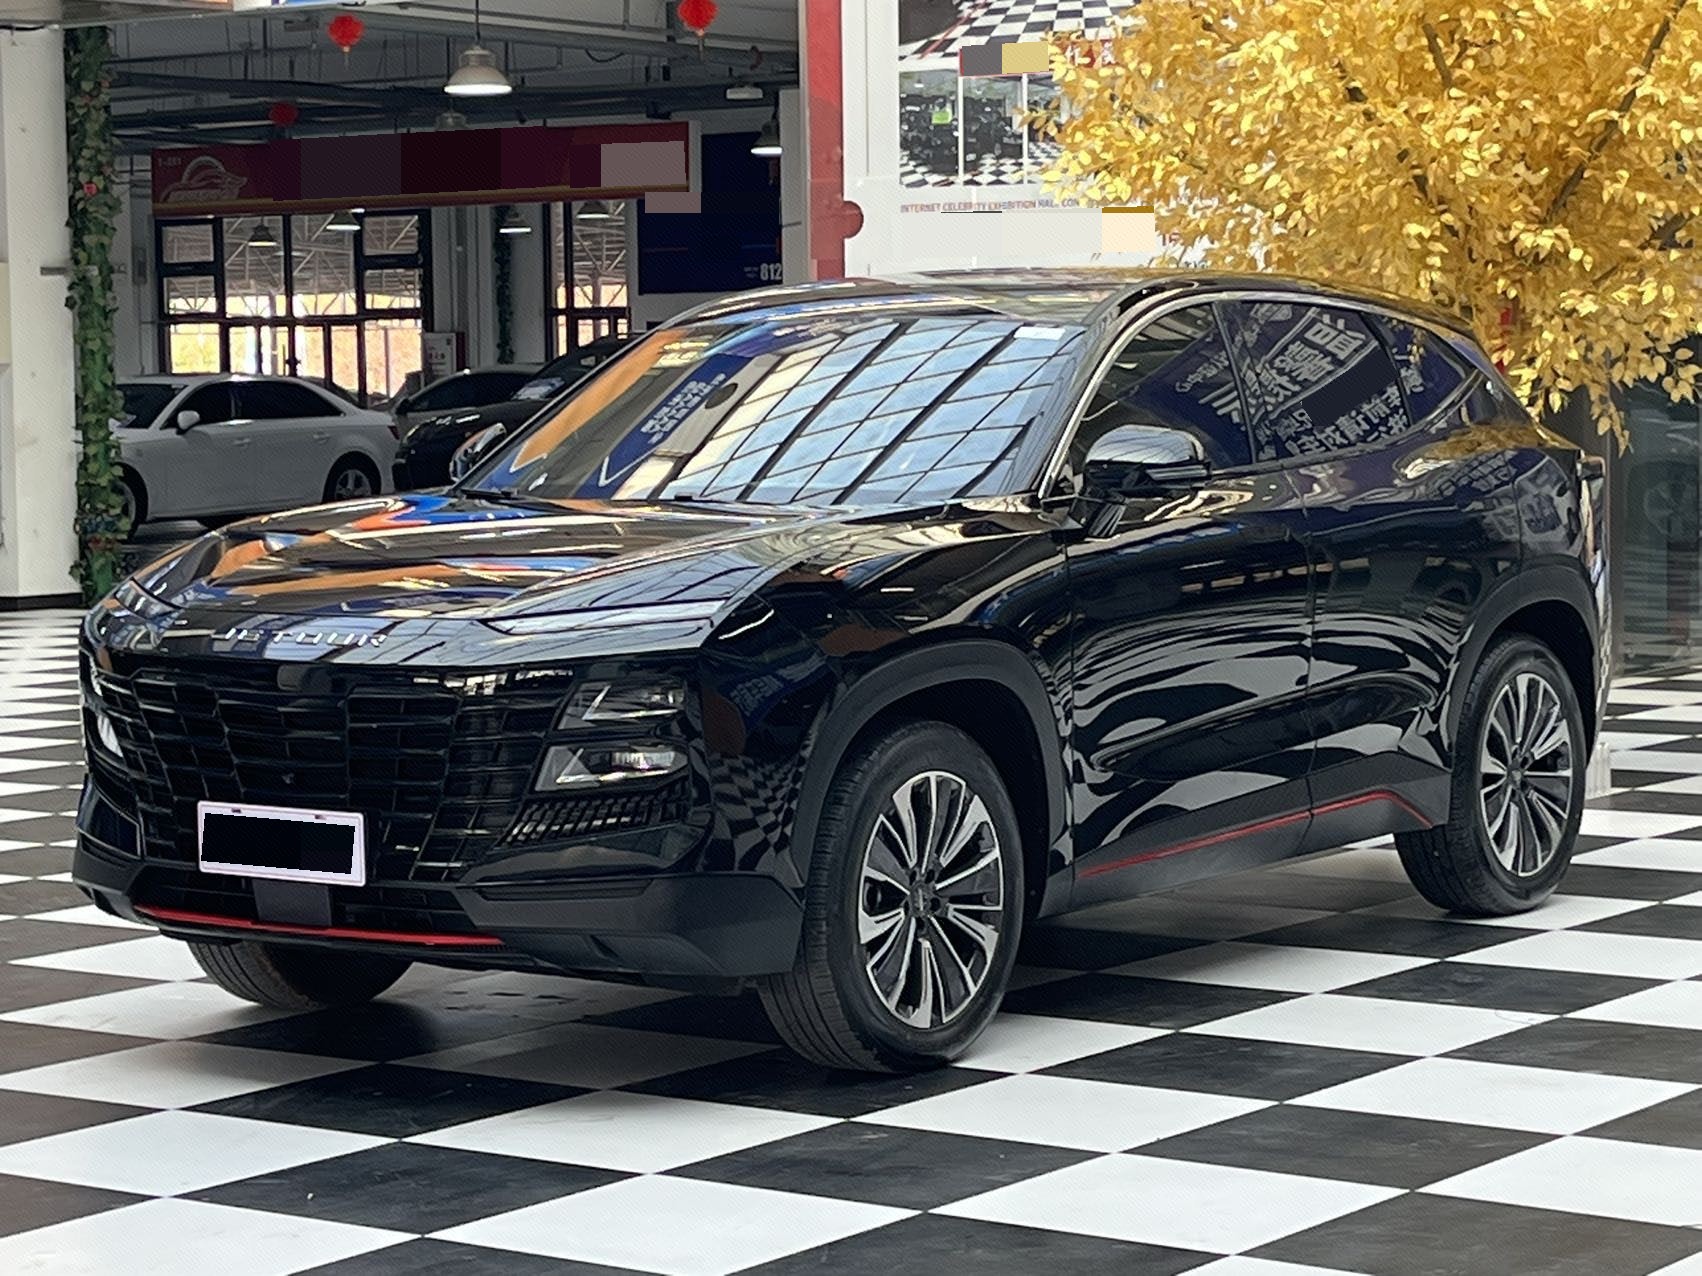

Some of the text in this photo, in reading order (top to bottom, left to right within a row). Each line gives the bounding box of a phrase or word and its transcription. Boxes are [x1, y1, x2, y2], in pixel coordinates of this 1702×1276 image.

[901, 203, 941, 214] INTERNET
[760, 263, 783, 281] 812
[212, 627, 388, 648] JETOUR
